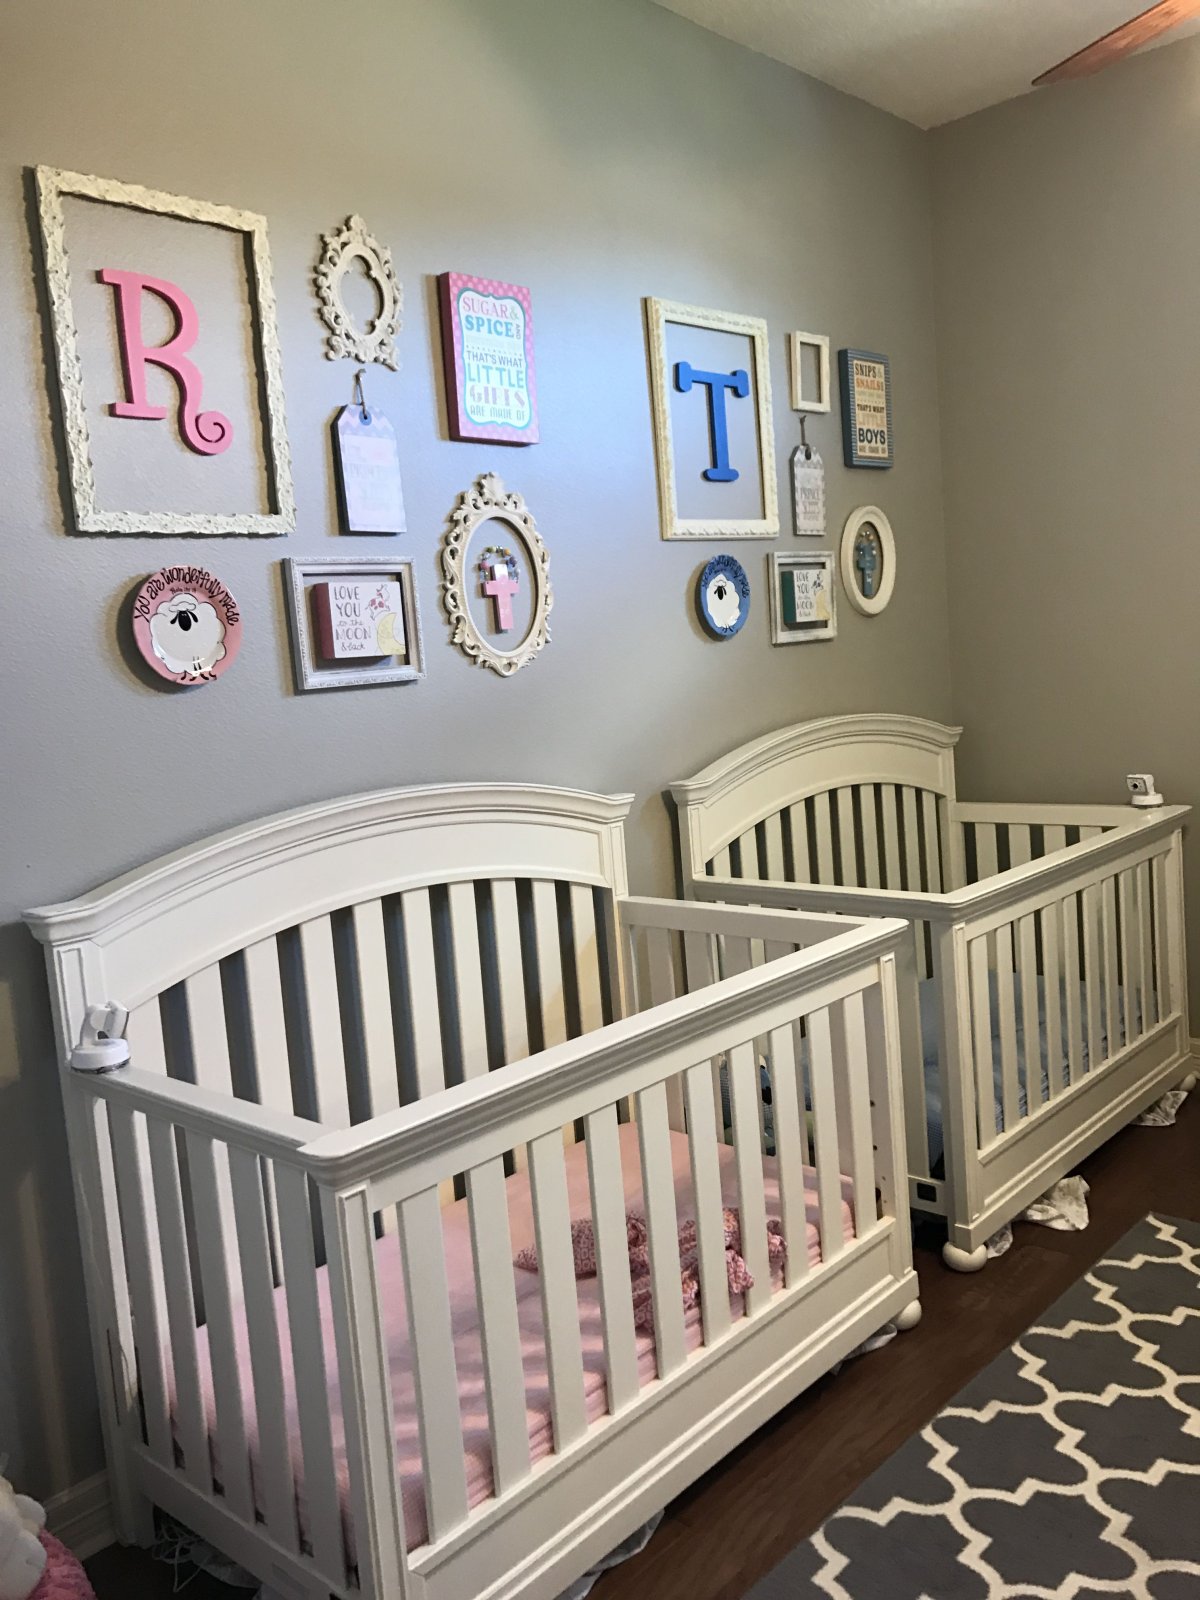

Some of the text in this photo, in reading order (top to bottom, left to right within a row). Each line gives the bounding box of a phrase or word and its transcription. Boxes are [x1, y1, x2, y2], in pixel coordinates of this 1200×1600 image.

[462, 296, 509, 320] SUGAR
[464, 314, 515, 338] SPICE
[96, 268, 234, 456] R
[466, 350, 524, 369] THAT'S WHAT
[854, 362, 877, 378] SNIPS
[466, 363, 525, 389] LITTLE
[674, 361, 749, 482] T
[857, 428, 886, 446] BOYS
[146, 579, 165, 601] are
[161, 566, 224, 599] wonderfully
[219, 592, 240, 626] made
[334, 586, 360, 601] LOVE
[336, 602, 361, 618] YOU
[335, 627, 372, 641] MOON
